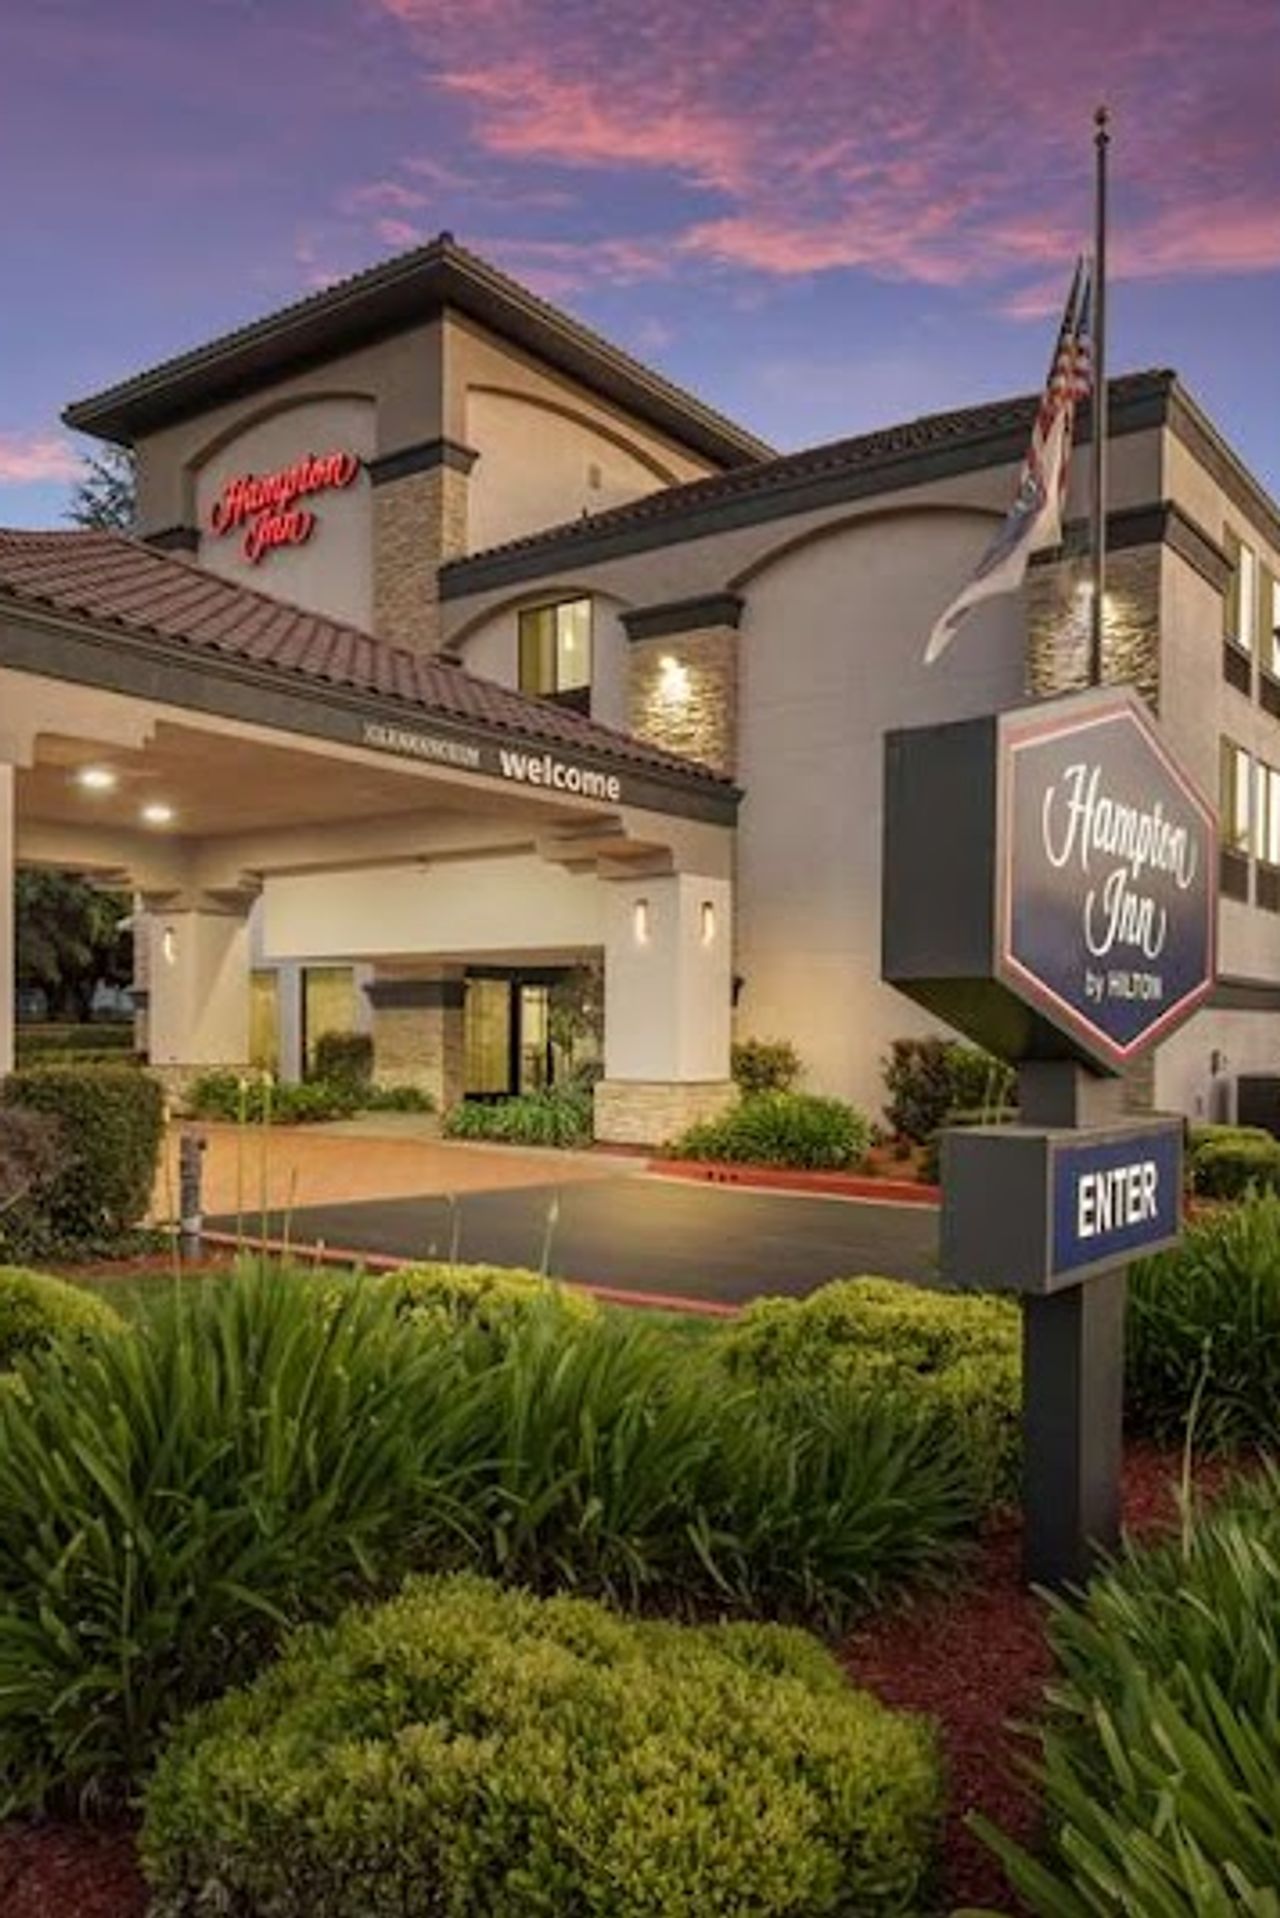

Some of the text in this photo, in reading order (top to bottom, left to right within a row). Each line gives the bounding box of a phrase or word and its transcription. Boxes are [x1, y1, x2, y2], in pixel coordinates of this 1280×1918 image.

[211, 451, 361, 535] Hampton
[244, 508, 316, 566] Inn
[500, 749, 620, 800] welcome
[1043, 763, 1197, 889] Hampton
[1085, 868, 1166, 960] Inn
[1085, 967, 1104, 1003] by
[1078, 1161, 1158, 1238] ENTER
